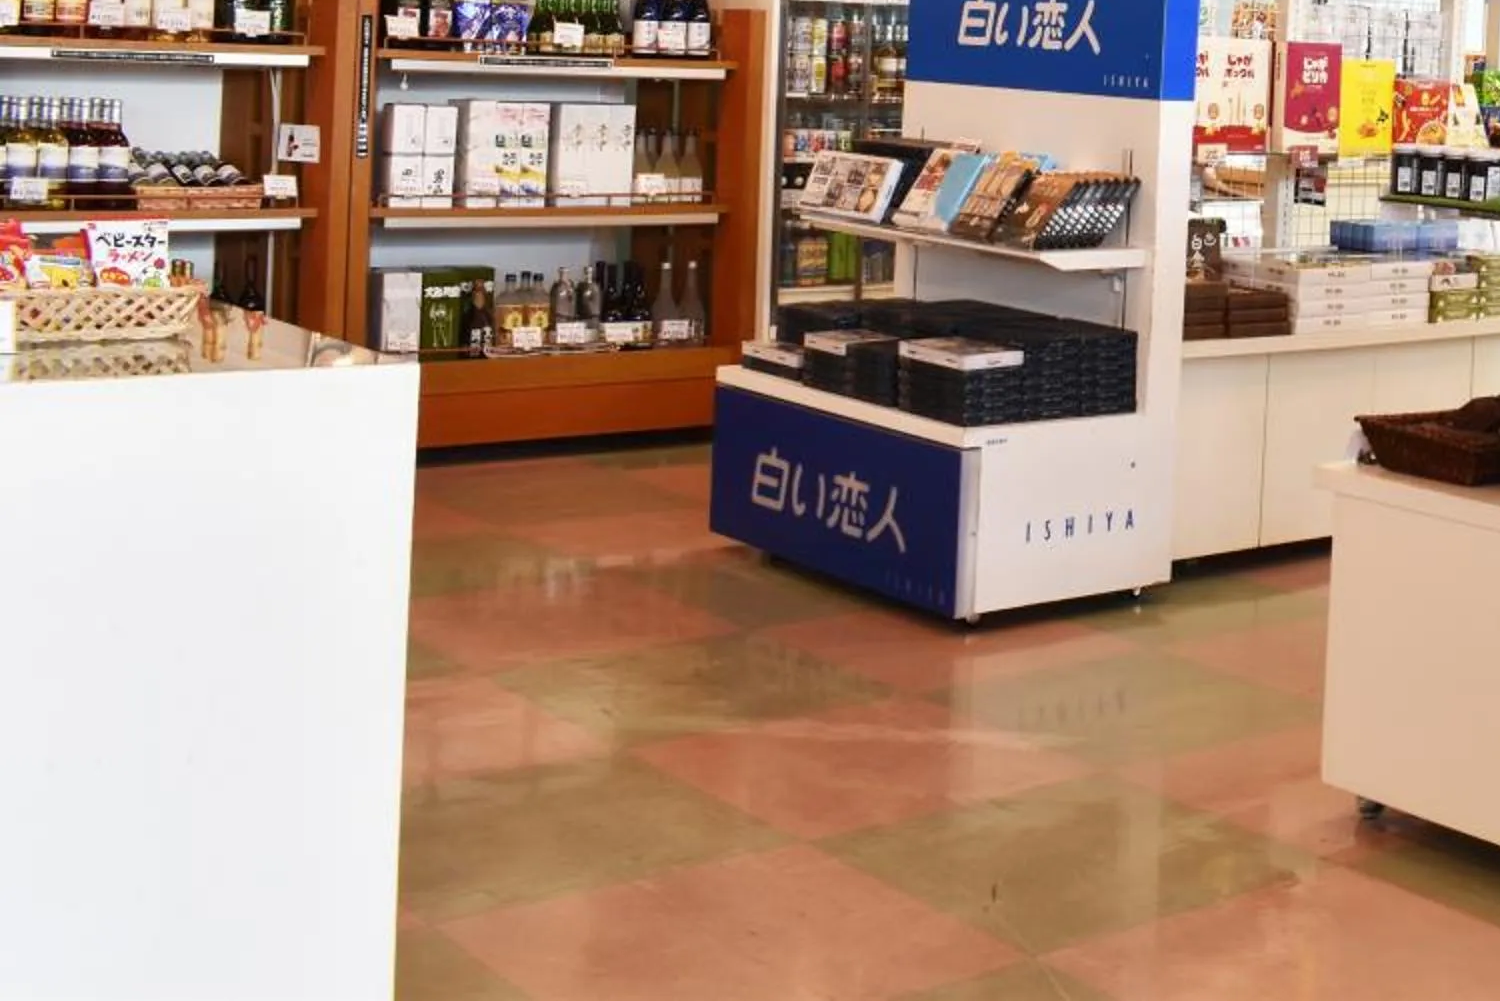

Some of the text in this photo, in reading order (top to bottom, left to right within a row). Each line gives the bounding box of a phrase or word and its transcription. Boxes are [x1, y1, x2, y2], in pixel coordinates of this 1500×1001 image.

[1227, 52, 1254, 66] じゃが
[1103, 73, 1149, 89] ISHIYA
[95, 232, 166, 248] ベビースター
[107, 248, 153, 263] ラーメン
[751, 446, 906, 554] 白い恋人
[1025, 509, 1136, 544] ISHIYA
